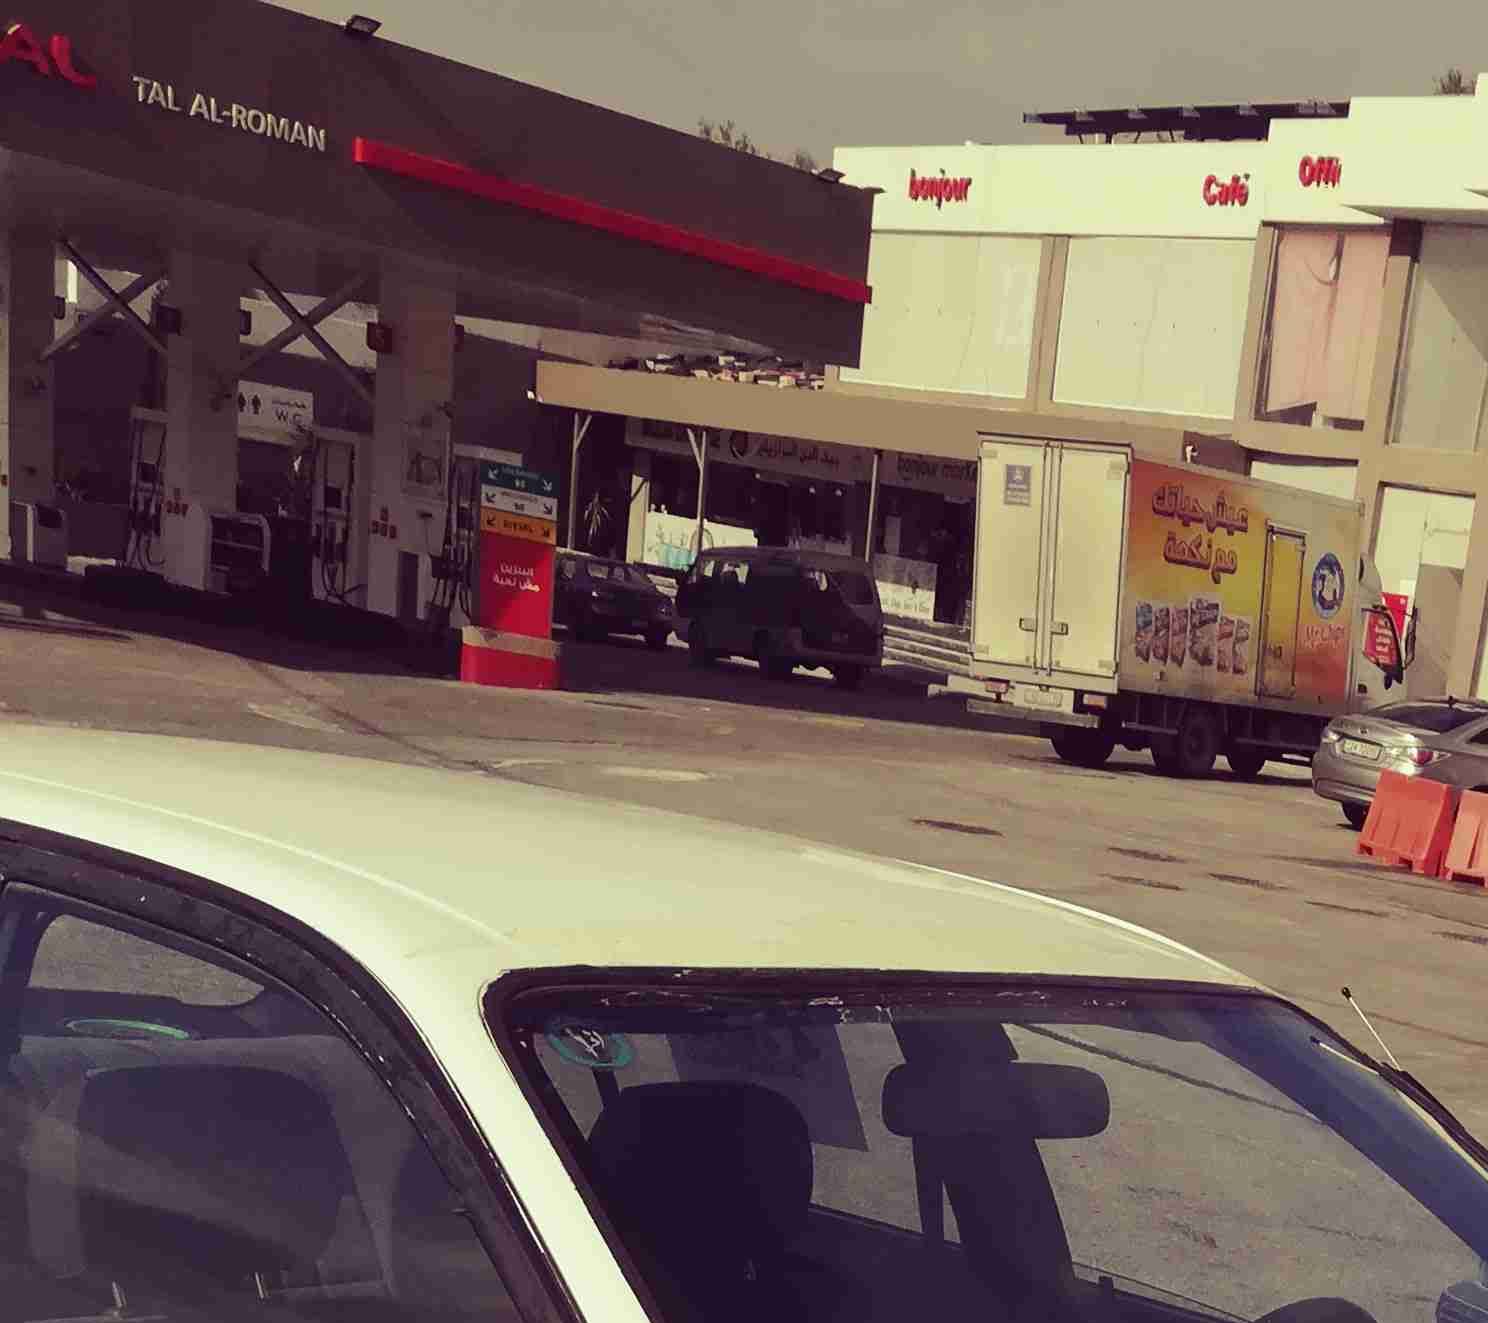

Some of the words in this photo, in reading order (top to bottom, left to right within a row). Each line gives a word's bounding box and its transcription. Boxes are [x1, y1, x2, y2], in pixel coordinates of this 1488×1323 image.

[132, 75, 182, 112] TAL
[189, 93, 326, 152] AL-ROMAN
[909, 168, 973, 209] bonjour
